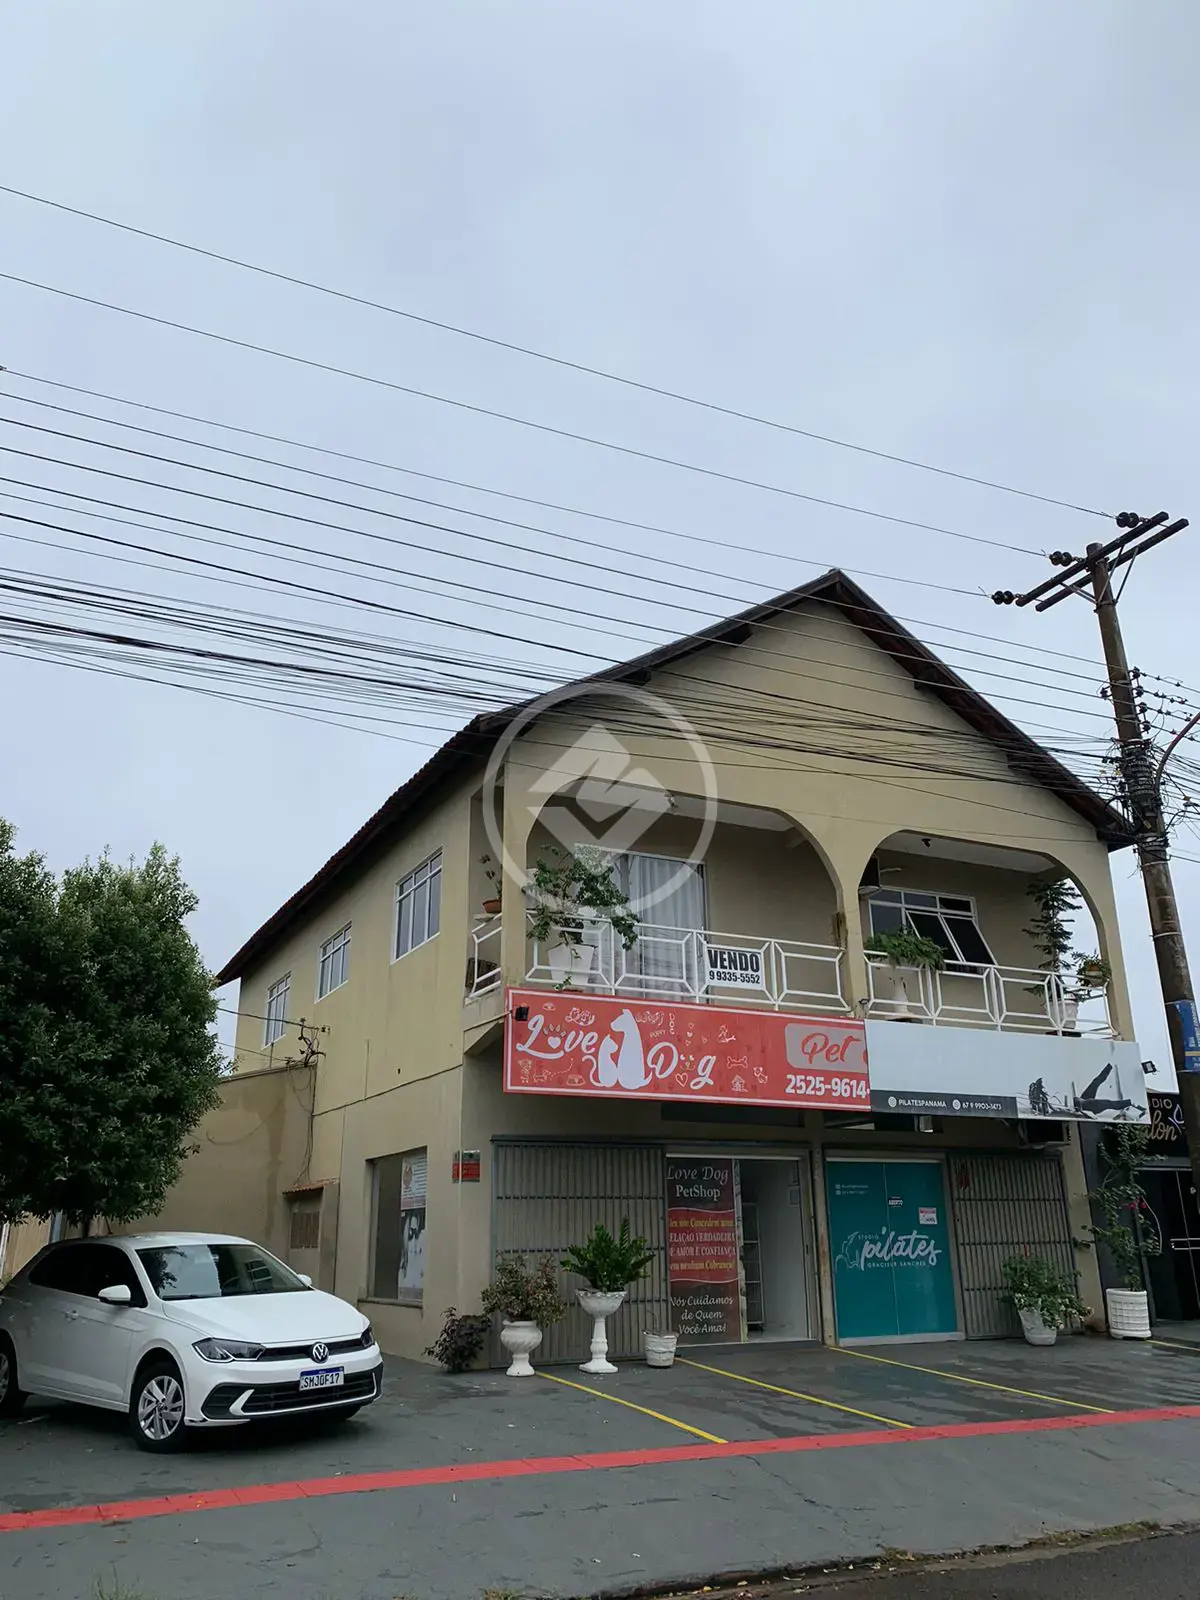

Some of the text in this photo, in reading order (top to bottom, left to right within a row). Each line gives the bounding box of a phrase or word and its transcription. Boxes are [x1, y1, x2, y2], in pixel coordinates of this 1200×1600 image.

[707, 949, 760, 973] VENDO
[709, 970, 760, 984] 9 9335-5552
[785, 1074, 867, 1099] 2525-9614
[898, 1098, 948, 1108] PILATESPANAMA
[1152, 1098, 1172, 1109] DIO
[666, 1165, 729, 1186] Love Dog
[676, 1184, 721, 1202] PetShop
[670, 1231, 735, 1244] ELAÇÃO VERDADEIRA
[677, 1246, 695, 1256] AMOR
[696, 1246, 701, 1256] E
[701, 1246, 736, 1258] CONFIANÇA
[861, 1226, 942, 1272] pilates
[687, 1295, 735, 1306] Cuidamos
[681, 1309, 724, 1322] de Quem
[679, 1322, 727, 1334] Você Ama!
